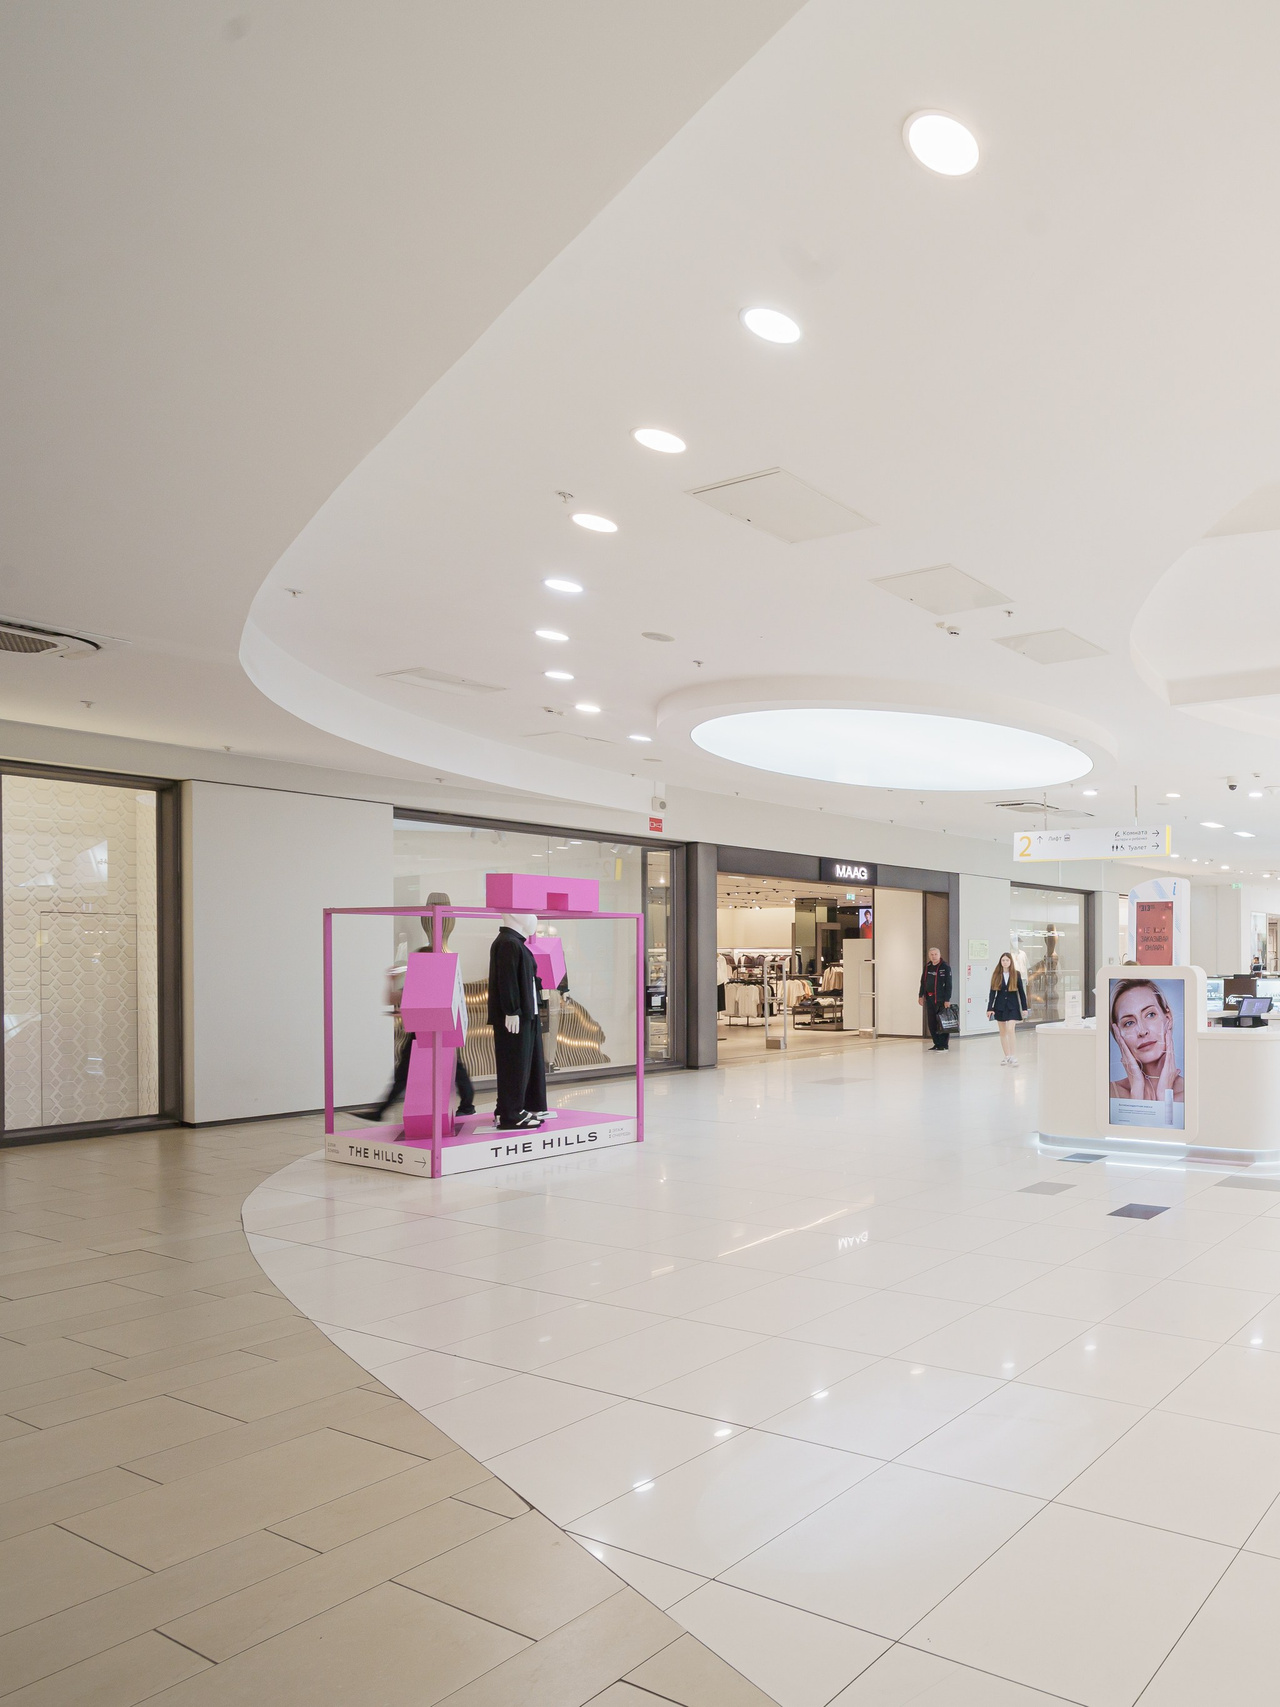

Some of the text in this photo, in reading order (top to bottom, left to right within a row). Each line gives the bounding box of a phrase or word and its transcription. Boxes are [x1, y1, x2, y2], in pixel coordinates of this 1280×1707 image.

[1019, 836, 1032, 857] 2
[835, 864, 868, 880] MAAG
[491, 1141, 533, 1158] THE
[542, 1131, 598, 1150] HILLS
[348, 1145, 404, 1165] THE HILLS
